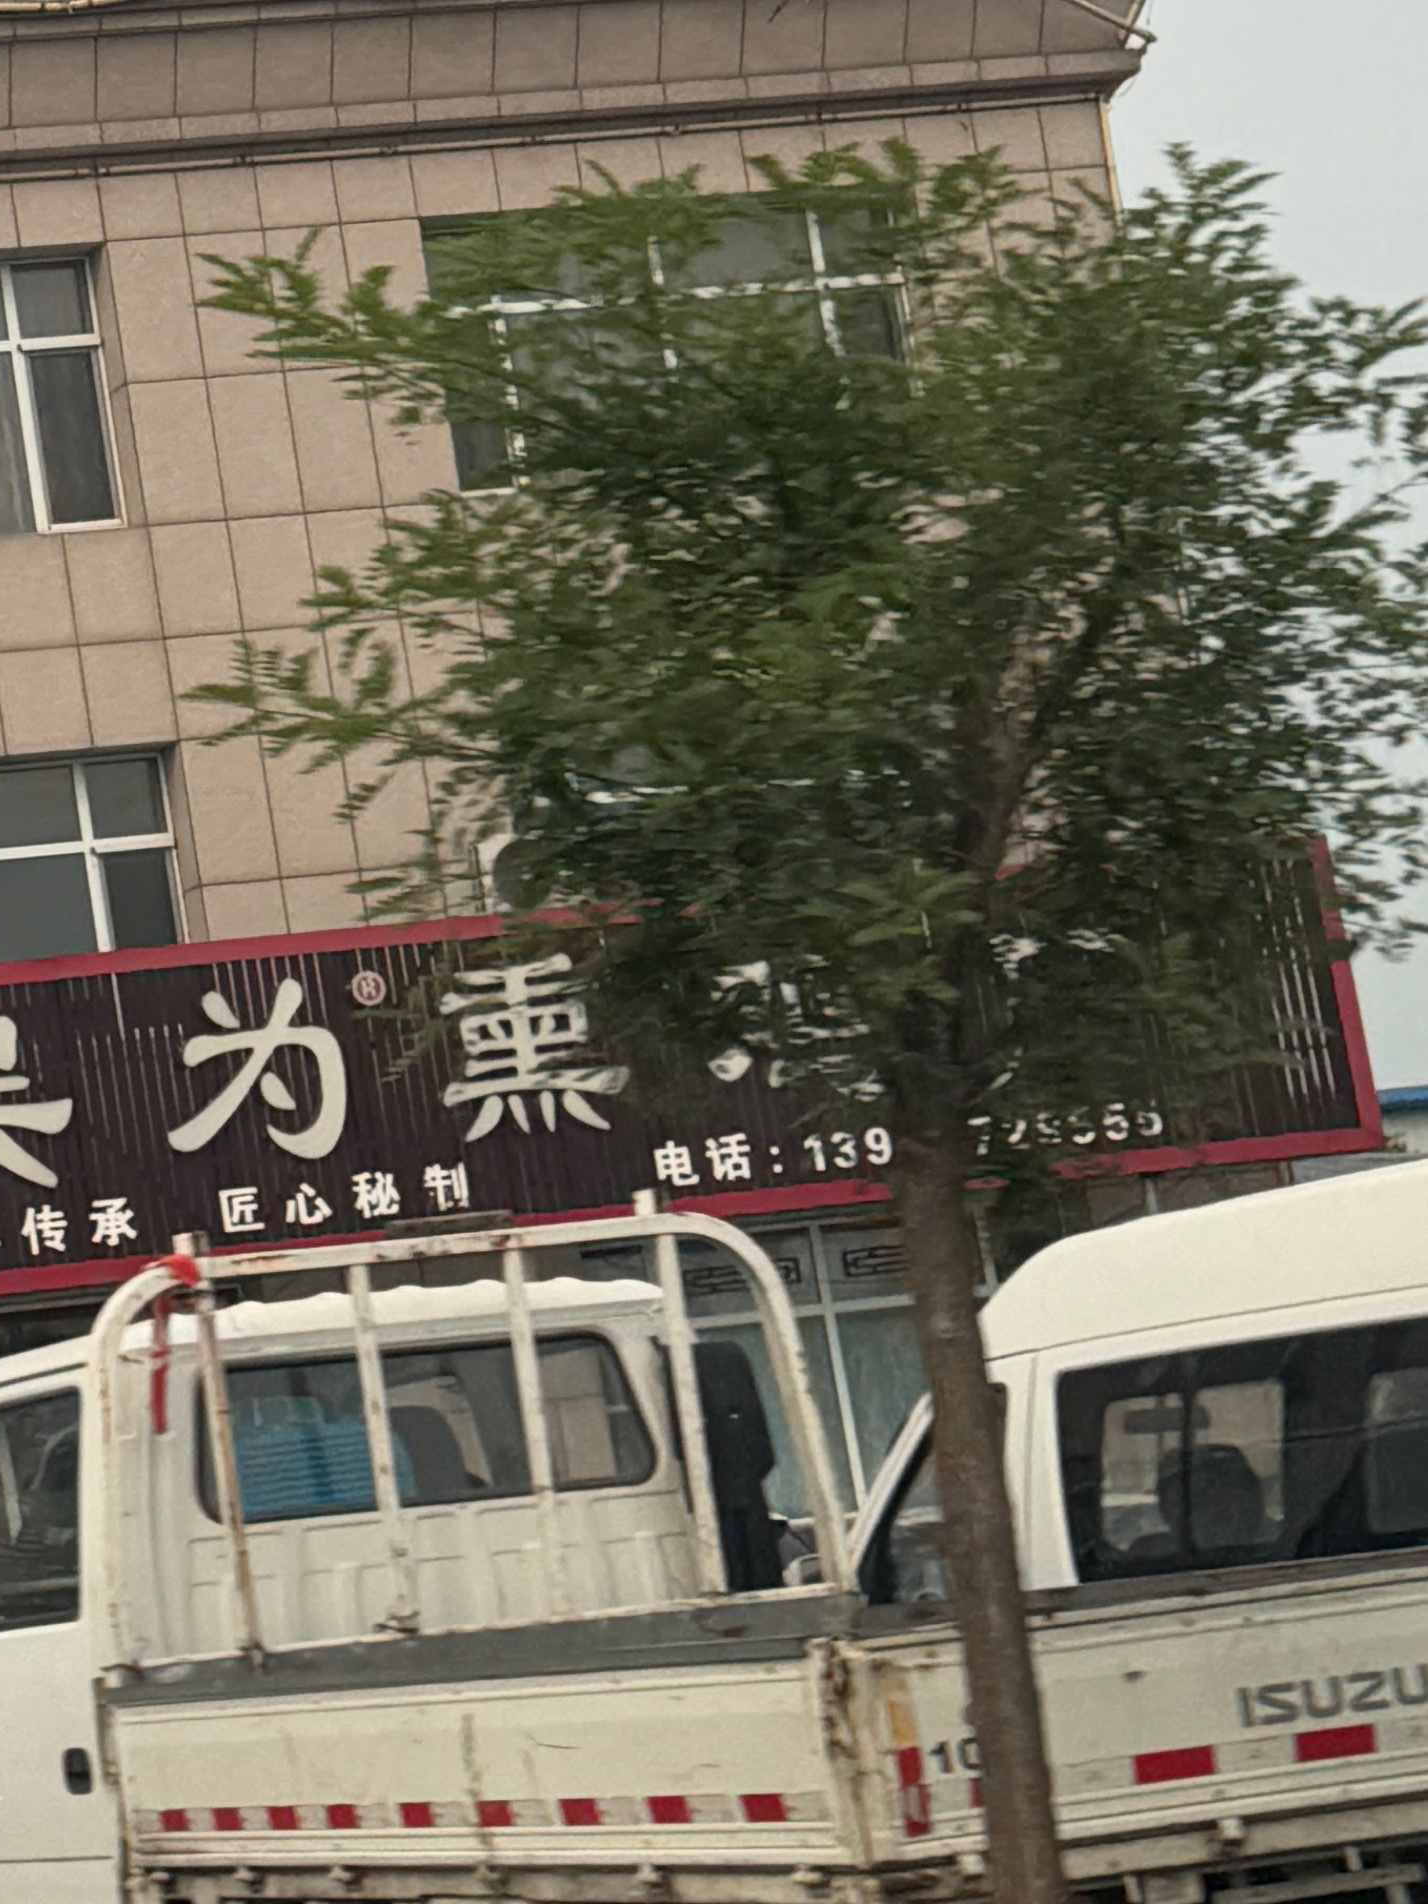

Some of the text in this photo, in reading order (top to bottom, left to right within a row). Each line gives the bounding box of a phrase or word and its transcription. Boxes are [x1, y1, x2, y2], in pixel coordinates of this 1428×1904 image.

[219, 1162, 471, 1234] 匠心秘制
[1236, 1662, 1428, 1729] ISUZU
